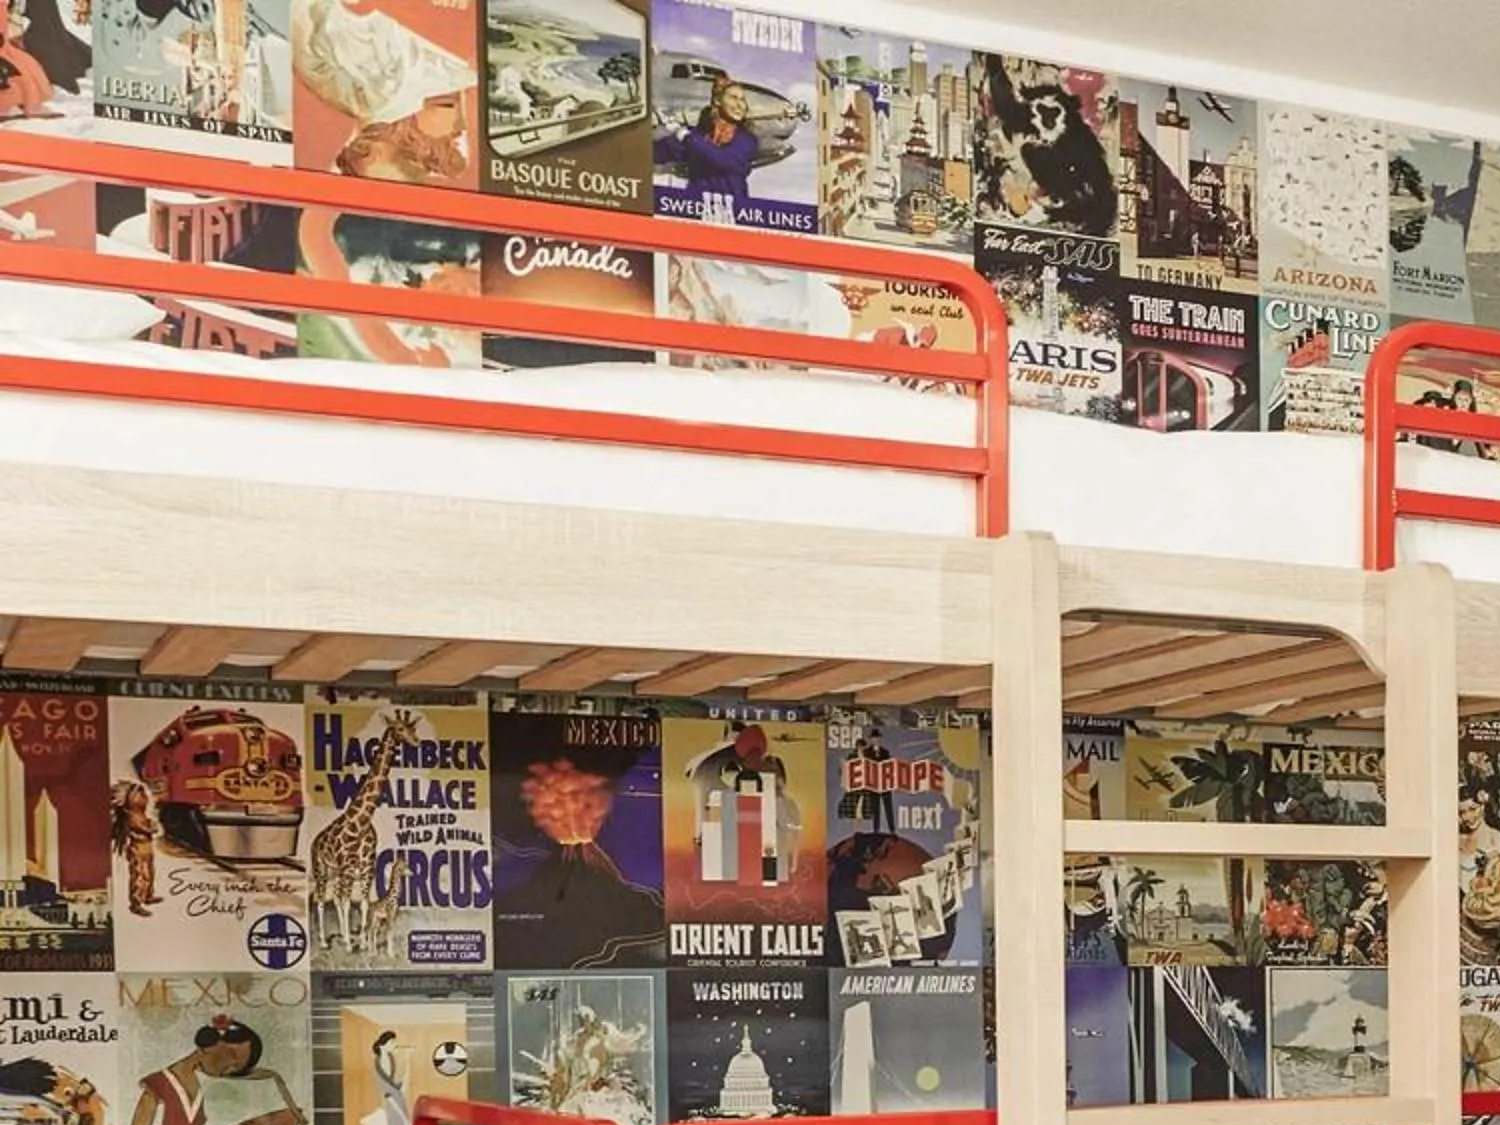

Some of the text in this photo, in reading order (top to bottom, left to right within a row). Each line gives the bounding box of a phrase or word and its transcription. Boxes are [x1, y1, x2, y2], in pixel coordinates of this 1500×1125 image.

[732, 9, 804, 53] SWEDEN
[101, 75, 190, 108] IBERIA
[103, 105, 283, 142] AIR LINES OF SPAIN
[491, 159, 572, 189] BASQUE
[578, 171, 642, 199] COAST
[737, 208, 764, 223] AIR
[769, 211, 812, 230] LINES
[984, 227, 1046, 255] Far East
[1045, 238, 1118, 270] SAS
[504, 236, 633, 279] Canada
[1393, 260, 1420, 278] FORT
[1136, 264, 1223, 290] TO GERMANY
[1273, 267, 1377, 293] ARIZONA
[940, 306, 964, 320] Club
[1128, 294, 1245, 333] THE TRAIN
[1265, 300, 1380, 331] CUNARD
[1131, 323, 1158, 338] GOES
[1009, 339, 1117, 373] ARIS
[1017, 368, 1100, 389] TWA JETS
[0, 697, 99, 721] AGO
[709, 708, 798, 721] UNITED
[43, 723, 96, 741] FAIR
[567, 719, 662, 747] MEXICO
[827, 724, 862, 750] see
[1066, 741, 1120, 761] MAIL
[848, 760, 945, 793] EUROPE
[395, 813, 457, 829] TRAINED
[898, 802, 944, 830] next
[396, 827, 485, 846] WILD ANIMAL
[168, 868, 219, 895] Every
[376, 849, 493, 909] CIRCUS
[186, 896, 248, 921] Chief
[251, 935, 304, 947] Santa Fe
[670, 923, 824, 956] ORIENT CALLS
[1143, 951, 1184, 965] TWA
[118, 978, 307, 1008] MEXICO
[692, 981, 804, 1001] WASHINGTON
[840, 975, 976, 995] AMERICAN AIRLINES
[0, 993, 104, 1024] mi &
[11, 1024, 119, 1045] Lauderdale
